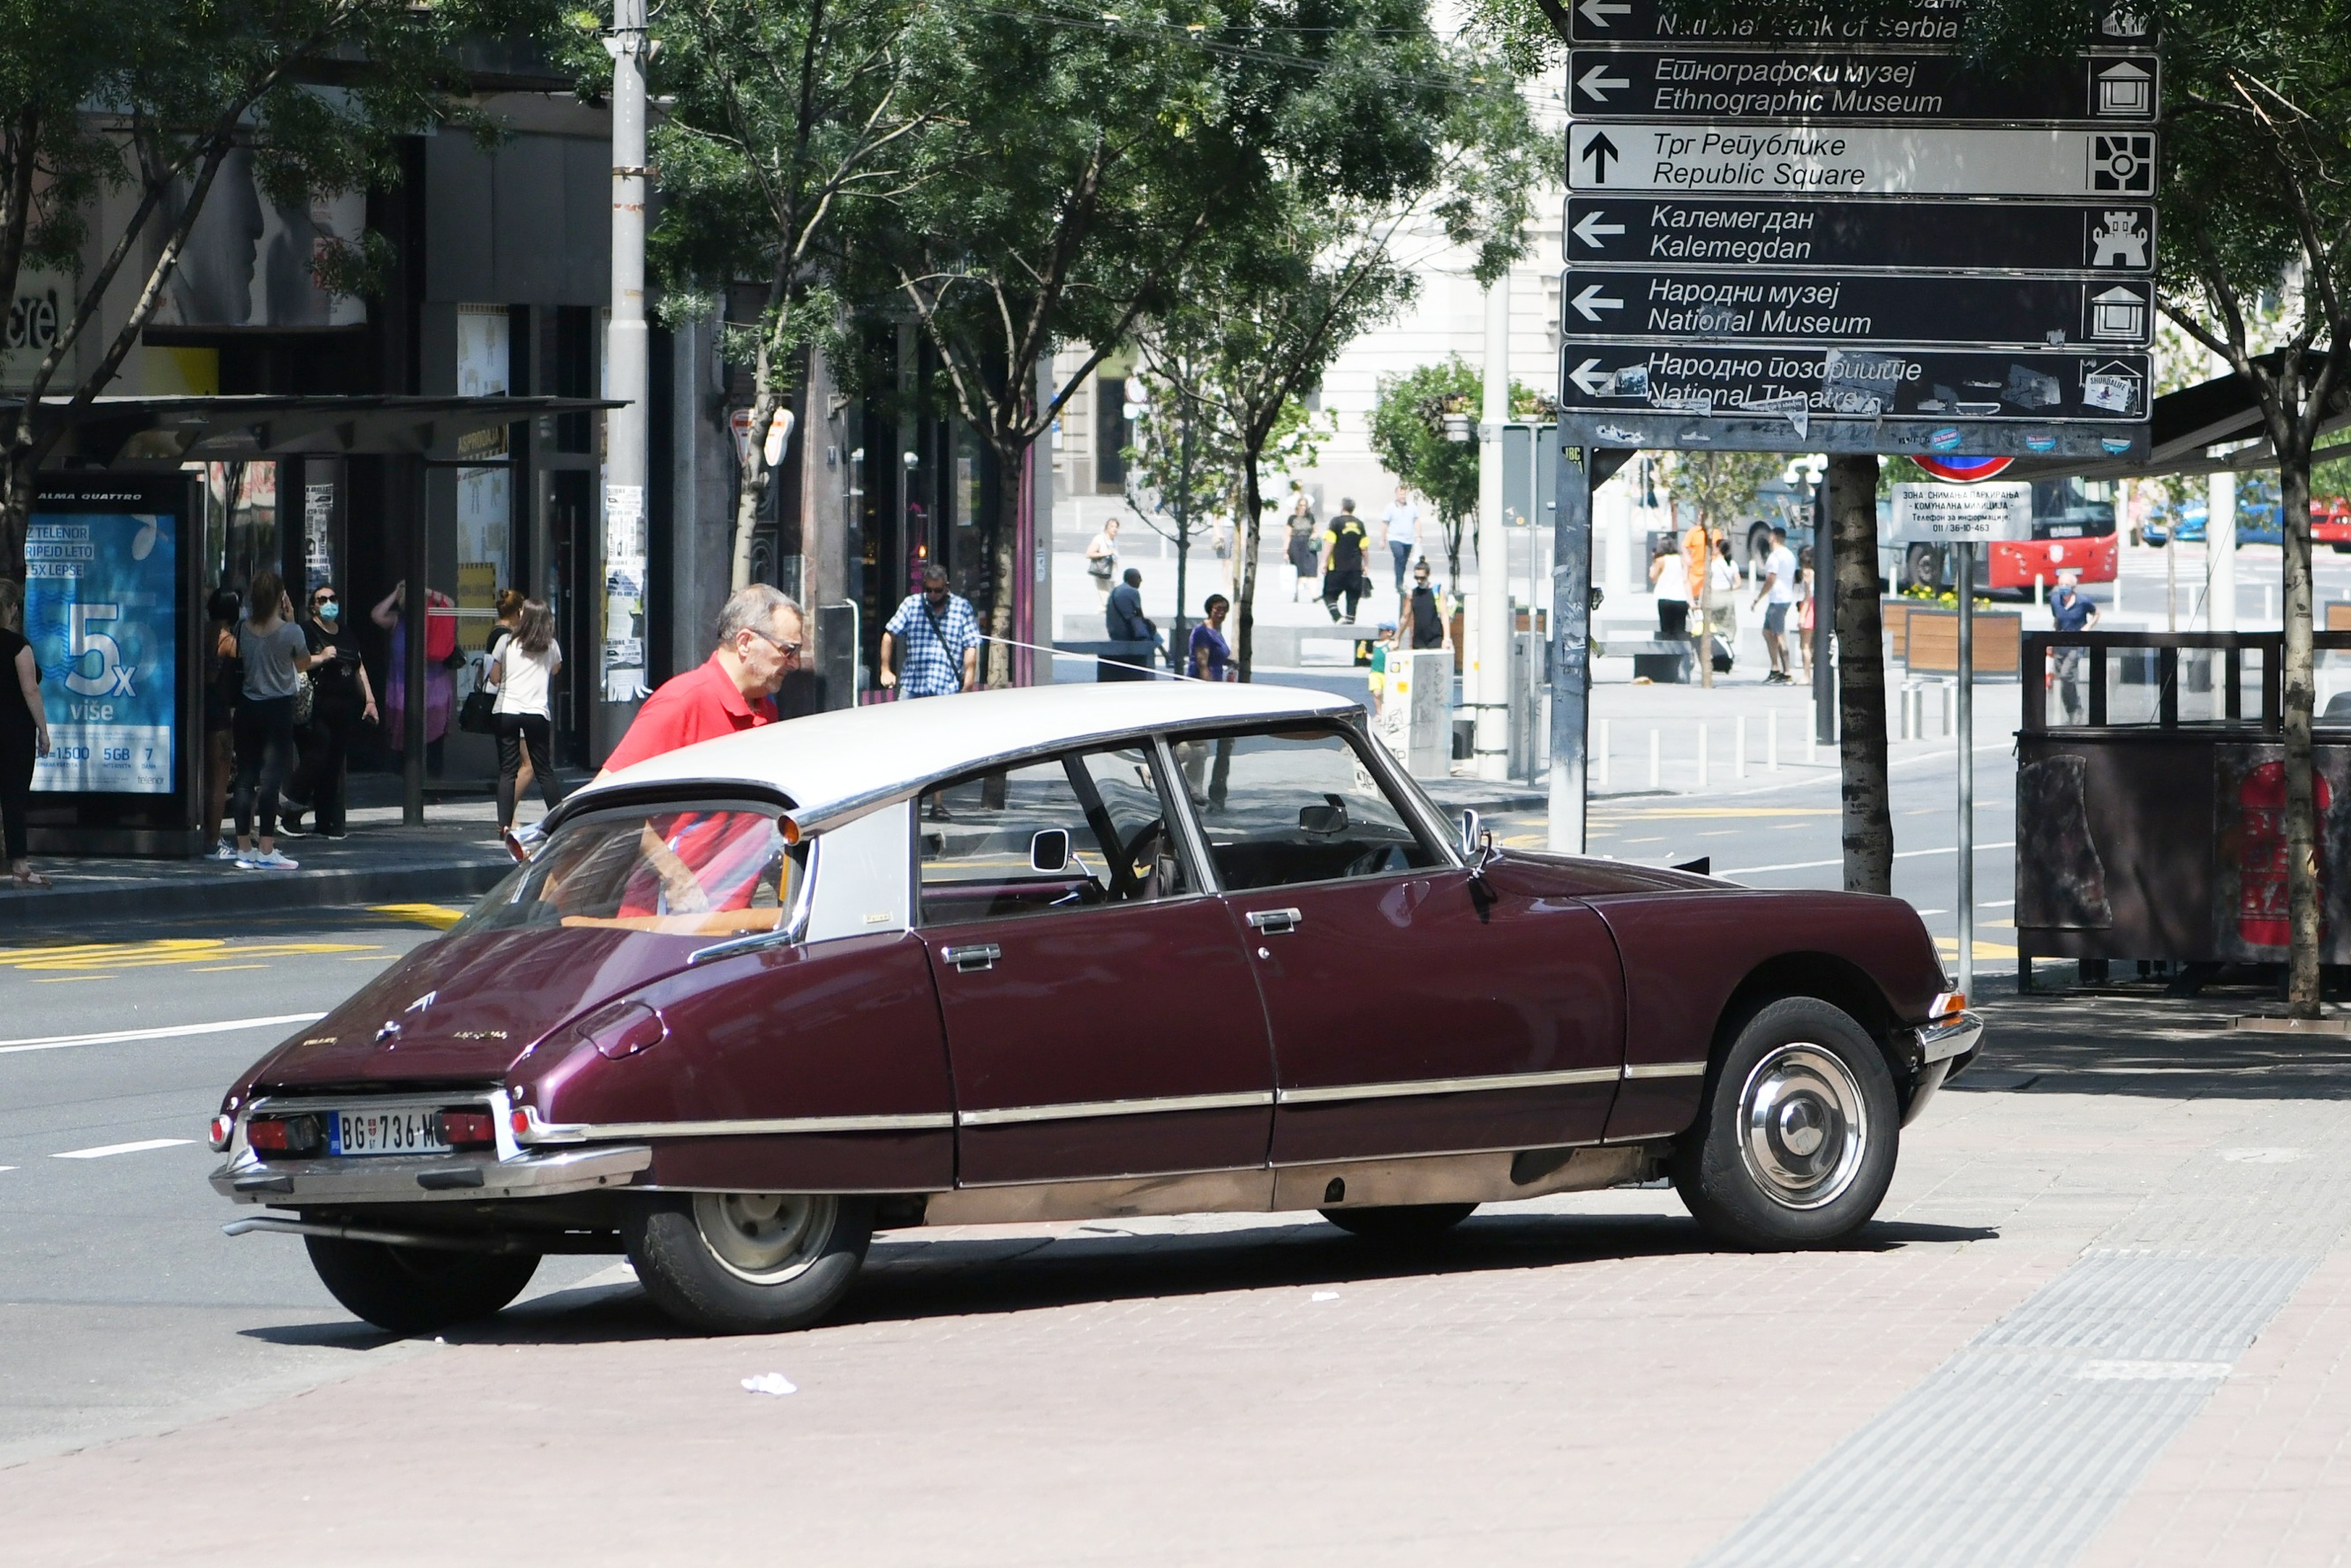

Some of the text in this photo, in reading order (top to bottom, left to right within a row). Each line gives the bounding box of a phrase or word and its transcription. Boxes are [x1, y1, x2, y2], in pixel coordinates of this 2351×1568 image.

[1655, 57, 1918, 88] Етнографски музеј
[1654, 87, 1942, 116] Ethnographic Museum
[1653, 132, 1846, 160] Трг Републике
[1653, 161, 1866, 190] Republic Square
[1650, 205, 1814, 233] Калемегдан
[1650, 234, 1812, 264] Kalemegdan
[1648, 278, 1841, 309] Народни музеј
[1647, 307, 1872, 334] National Museum
[1647, 352, 1762, 381] Народно
[1647, 381, 1754, 407] National
[1903, 491, 1924, 499] ЗОНА
[1970, 491, 2019, 499] ПАРКИРАЊА
[1964, 501, 2008, 511] МИЛИЦИЈА
[1912, 513, 1945, 521] Телефон
[36, 527, 87, 539] TELENOR
[64, 545, 93, 558] LETO
[31, 564, 46, 576] 5X
[70, 700, 114, 721] više
[145, 747, 153, 761] 7
[138, 776, 164, 784] telenor
[342, 1116, 364, 1151] BG
